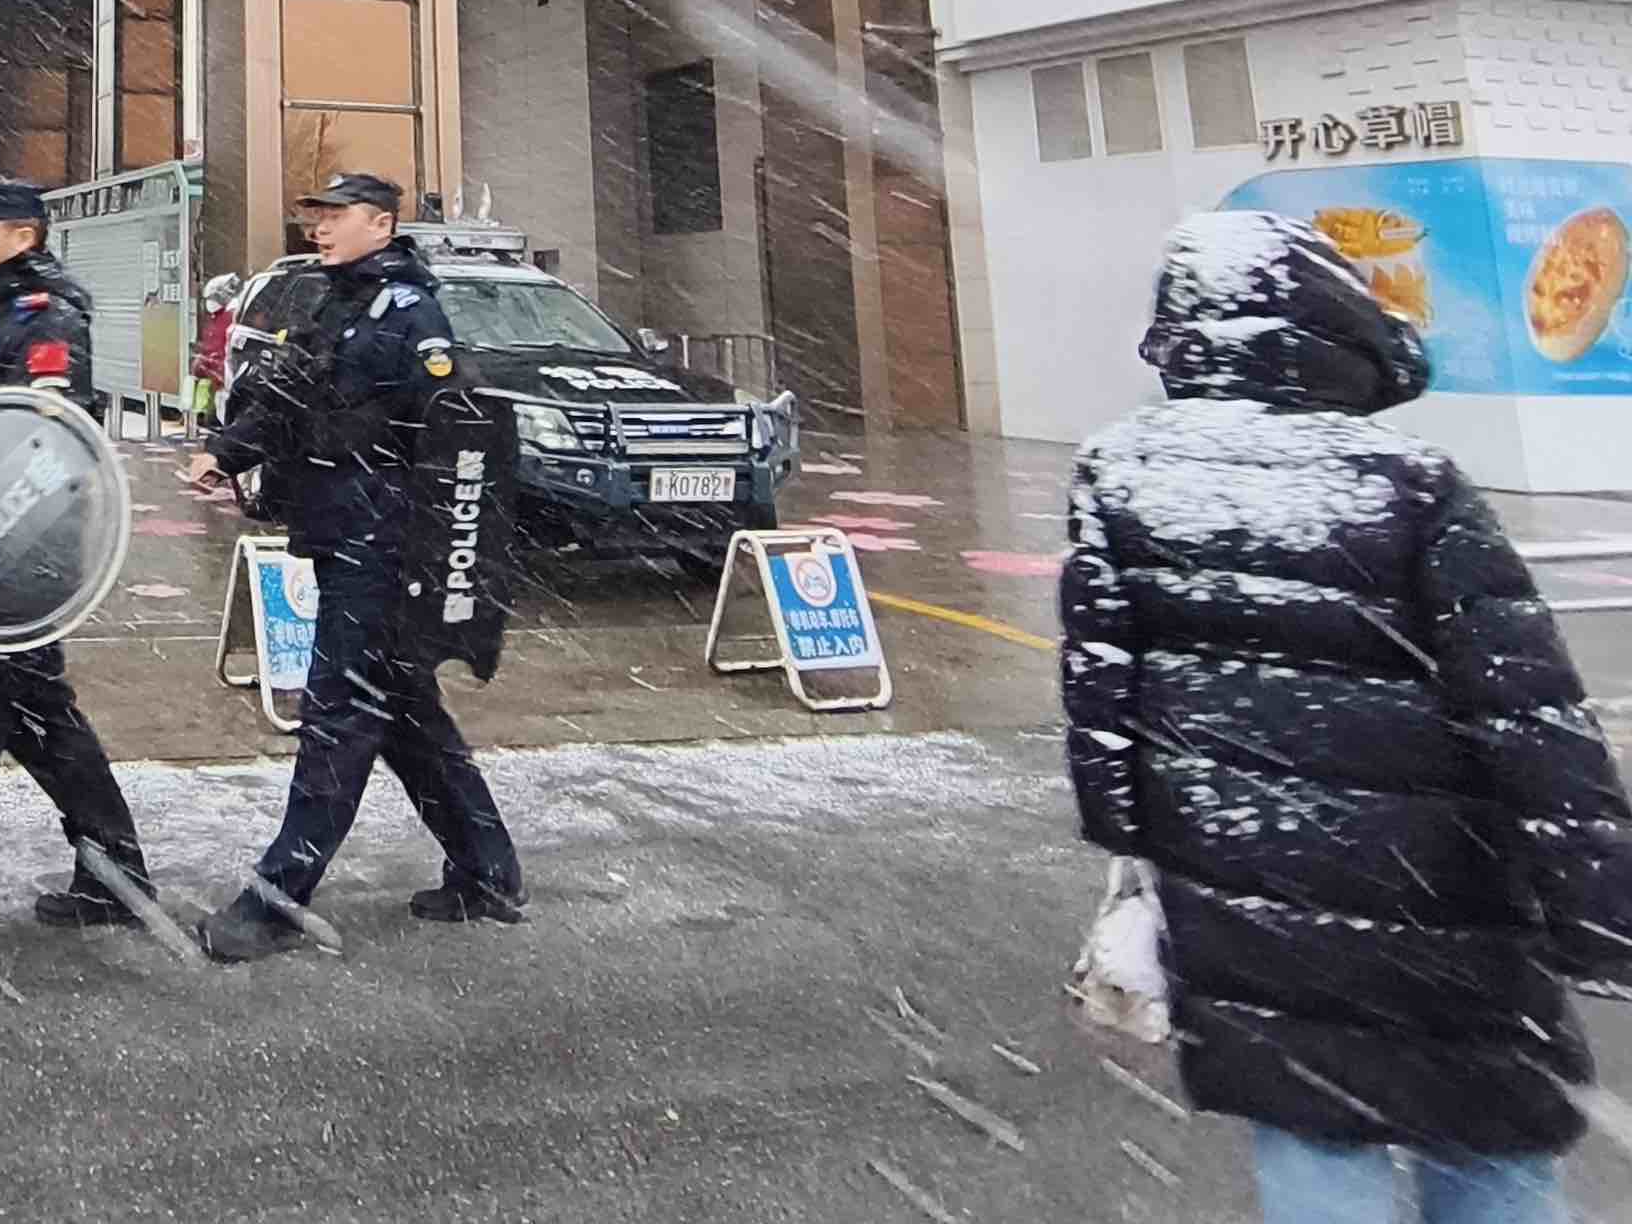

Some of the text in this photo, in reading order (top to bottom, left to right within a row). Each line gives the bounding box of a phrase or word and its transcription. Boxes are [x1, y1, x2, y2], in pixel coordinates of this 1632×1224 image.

[1260, 101, 1465, 162] 开心草帽
[446, 482, 484, 590] POLICE
